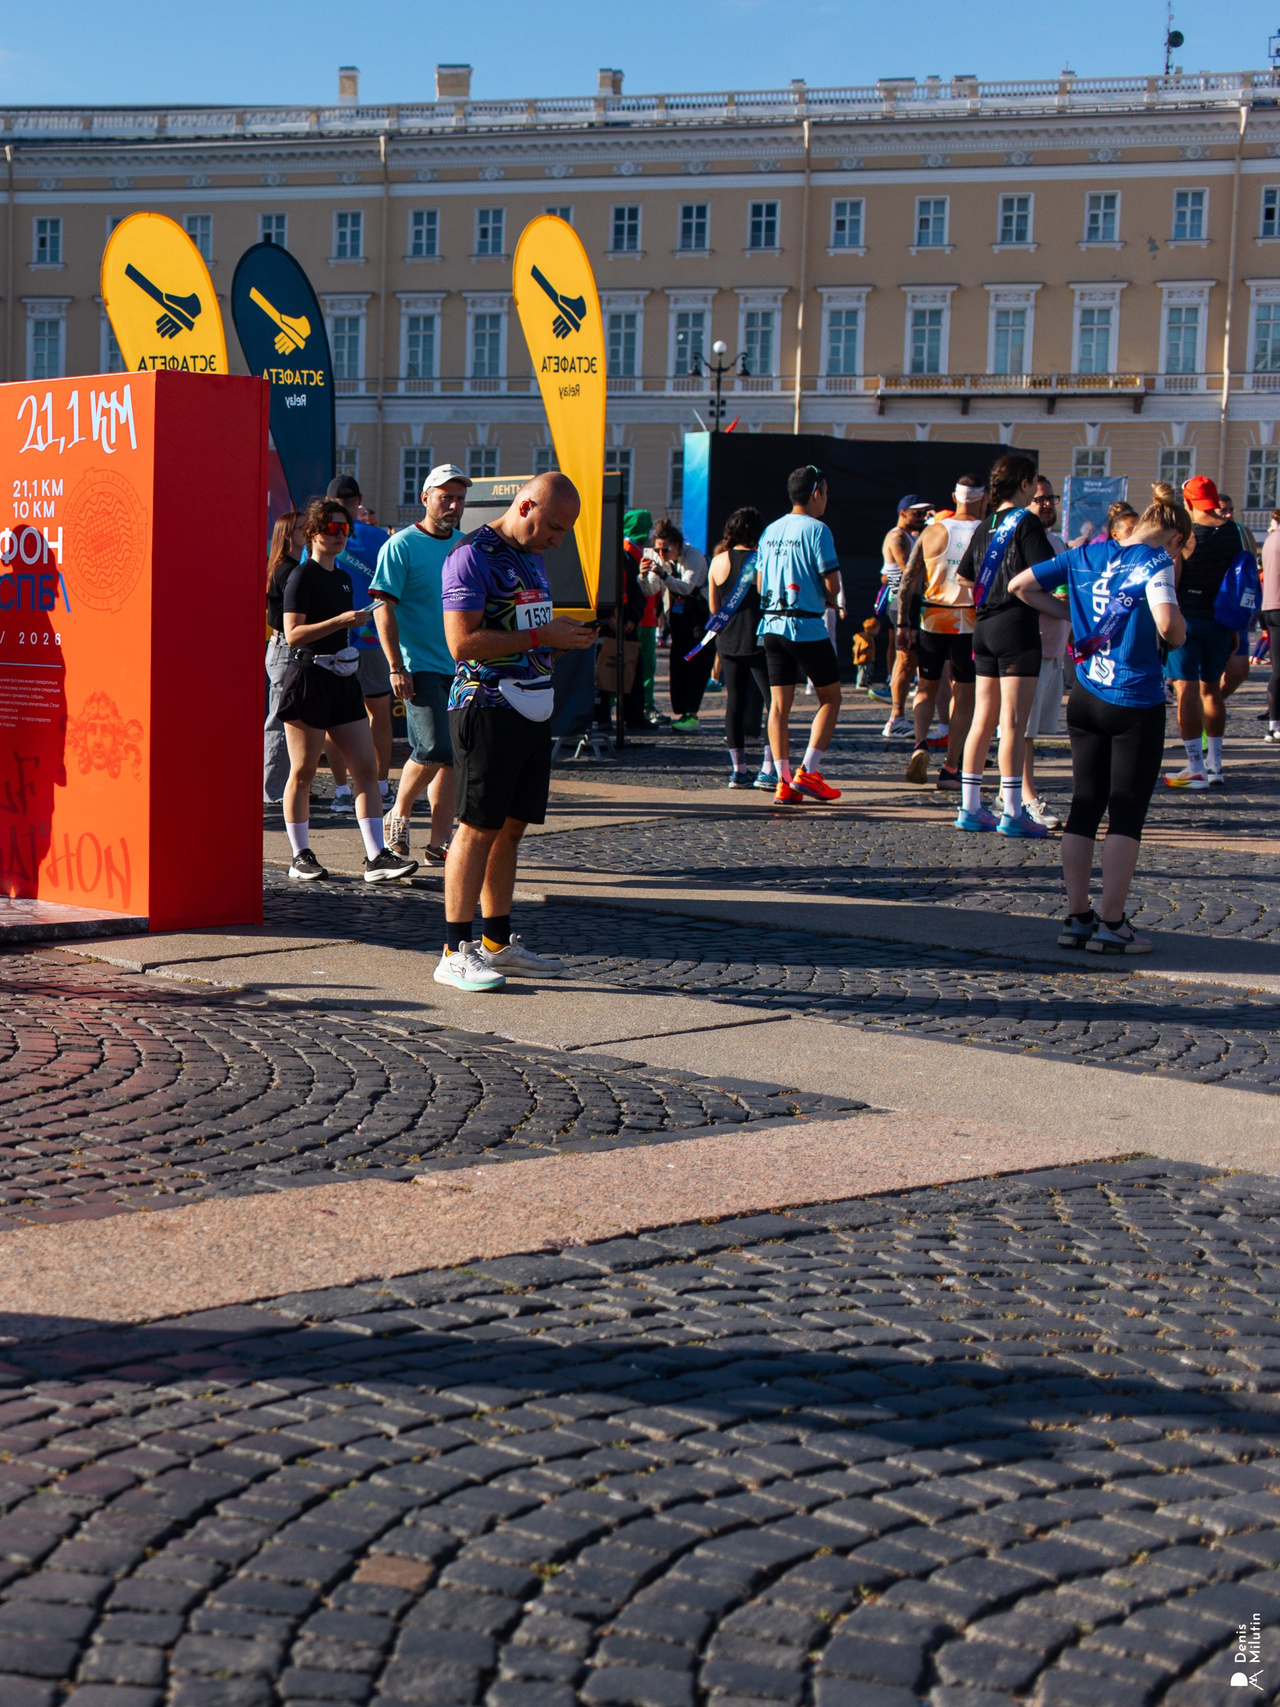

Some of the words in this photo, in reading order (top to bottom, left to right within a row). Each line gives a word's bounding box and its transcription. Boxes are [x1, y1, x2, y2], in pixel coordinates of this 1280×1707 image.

[13, 480, 38, 500] 21,1
[13, 501, 29, 518] 10
[990, 550, 998, 560] 2
[1115, 592, 1134, 607] 26
[525, 606, 551, 628] 1537
[717, 612, 730, 622] 36
[19, 632, 62, 646] 2026
